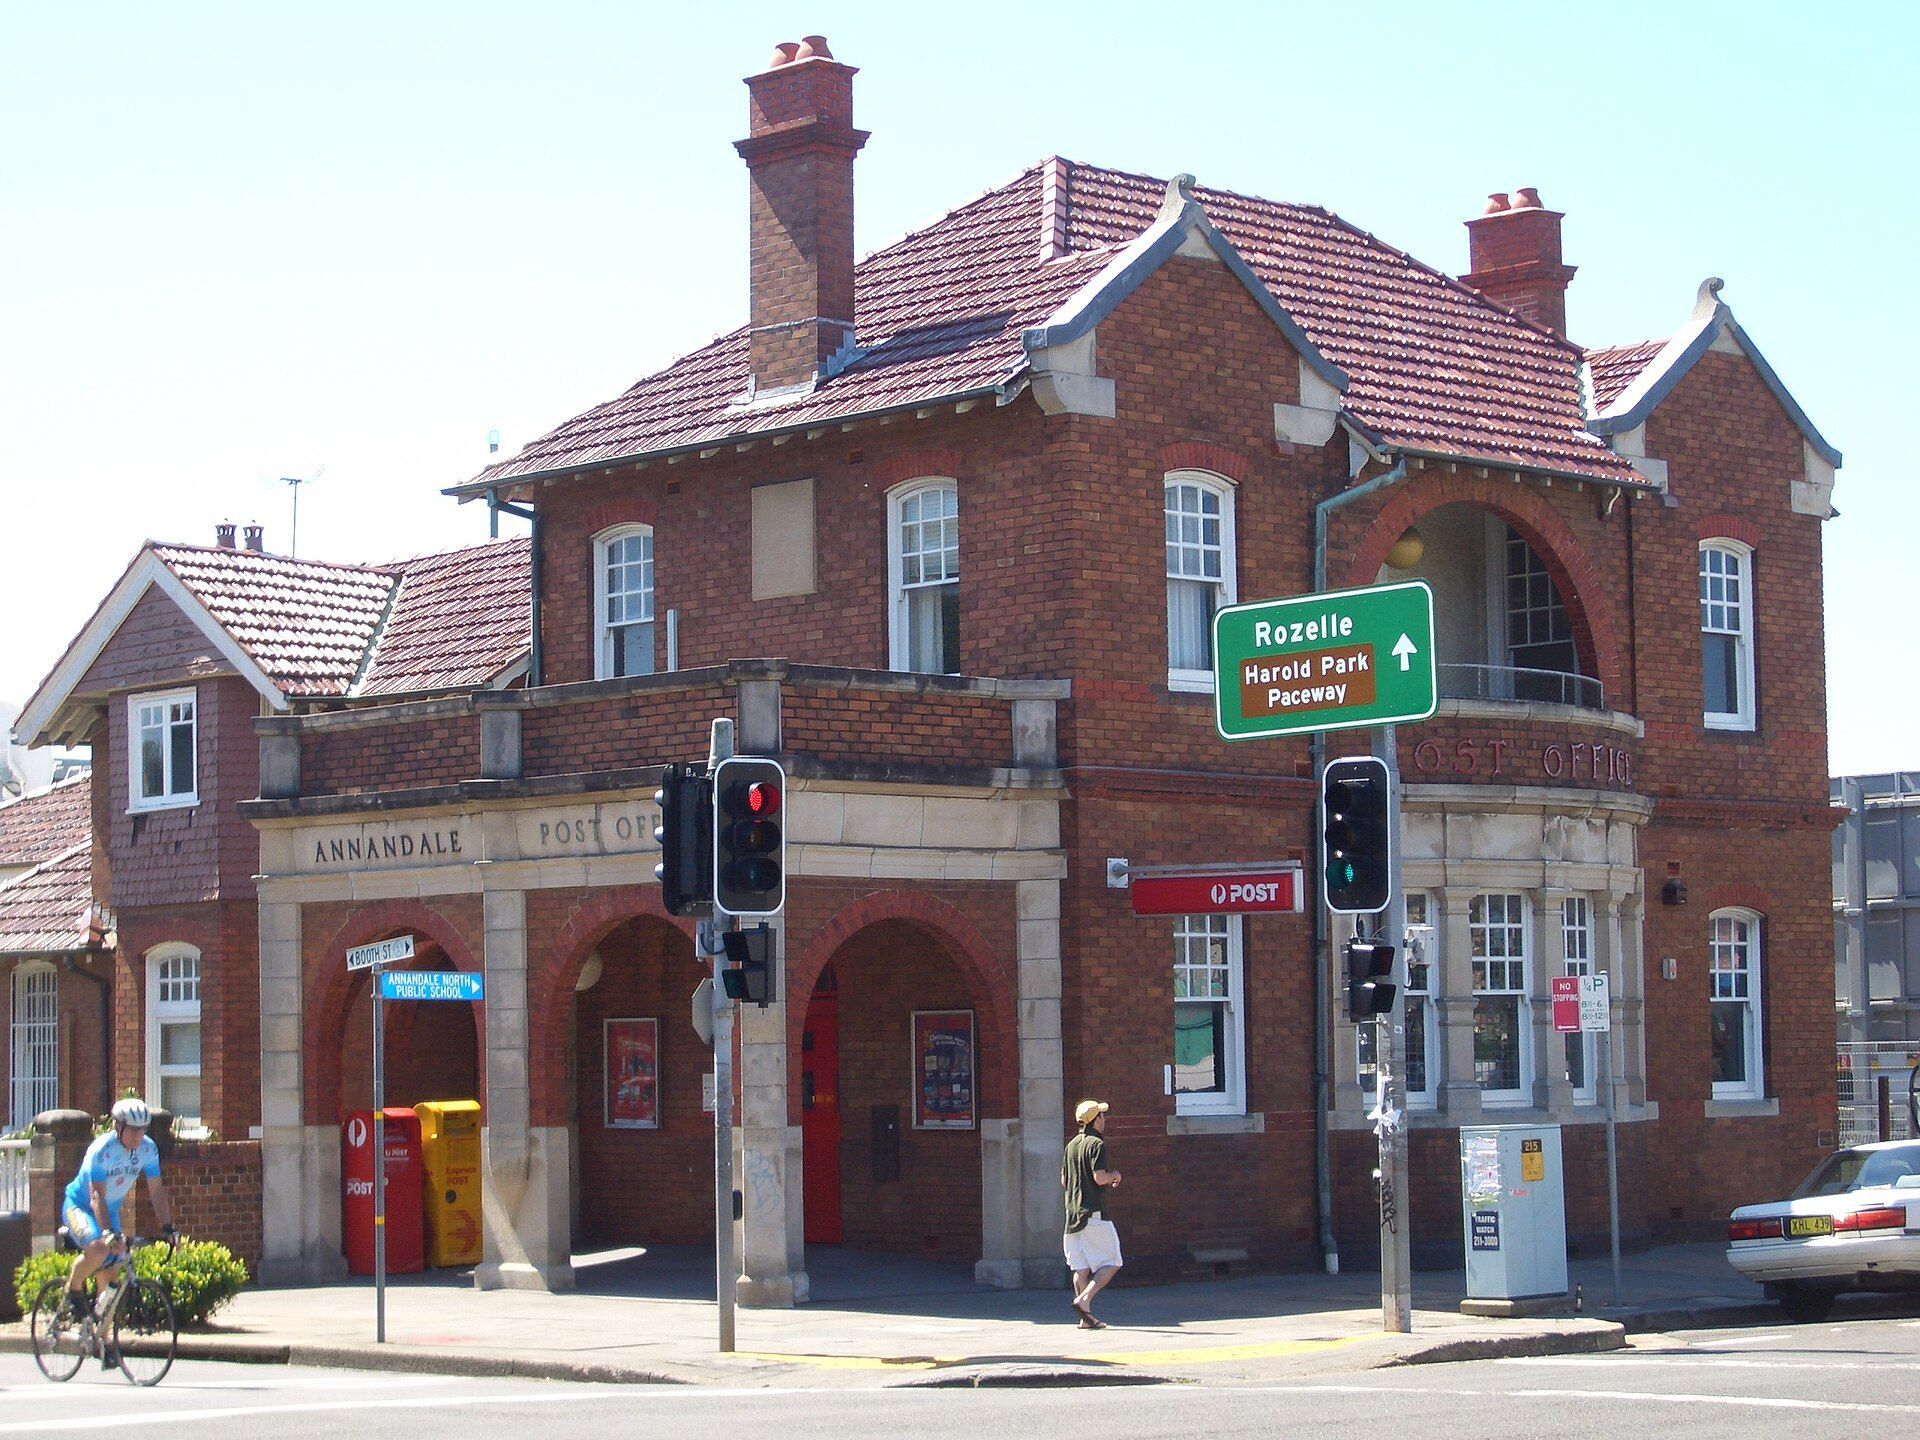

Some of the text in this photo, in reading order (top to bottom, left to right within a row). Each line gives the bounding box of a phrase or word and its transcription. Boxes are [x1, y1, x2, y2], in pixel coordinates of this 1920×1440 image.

[1254, 612, 1353, 648] Rozelle
[1244, 651, 1369, 686] Harold Park
[1268, 683, 1347, 708] Paceway
[1414, 738, 1507, 776] OST
[1543, 743, 1632, 786] OFFICE
[539, 819, 602, 845] POST
[315, 830, 462, 862] ANNANDALE
[1230, 883, 1279, 902] POST
[355, 944, 391, 966] BOOTH ST
[388, 973, 471, 987] ANNANDALE NORTH
[1559, 982, 1571, 991] NO
[396, 985, 463, 998] PUBLIC SCHOOL
[1524, 1141, 1538, 1151] 215
[347, 1181, 374, 1195] POST
[1792, 1219, 1810, 1231] XHL
